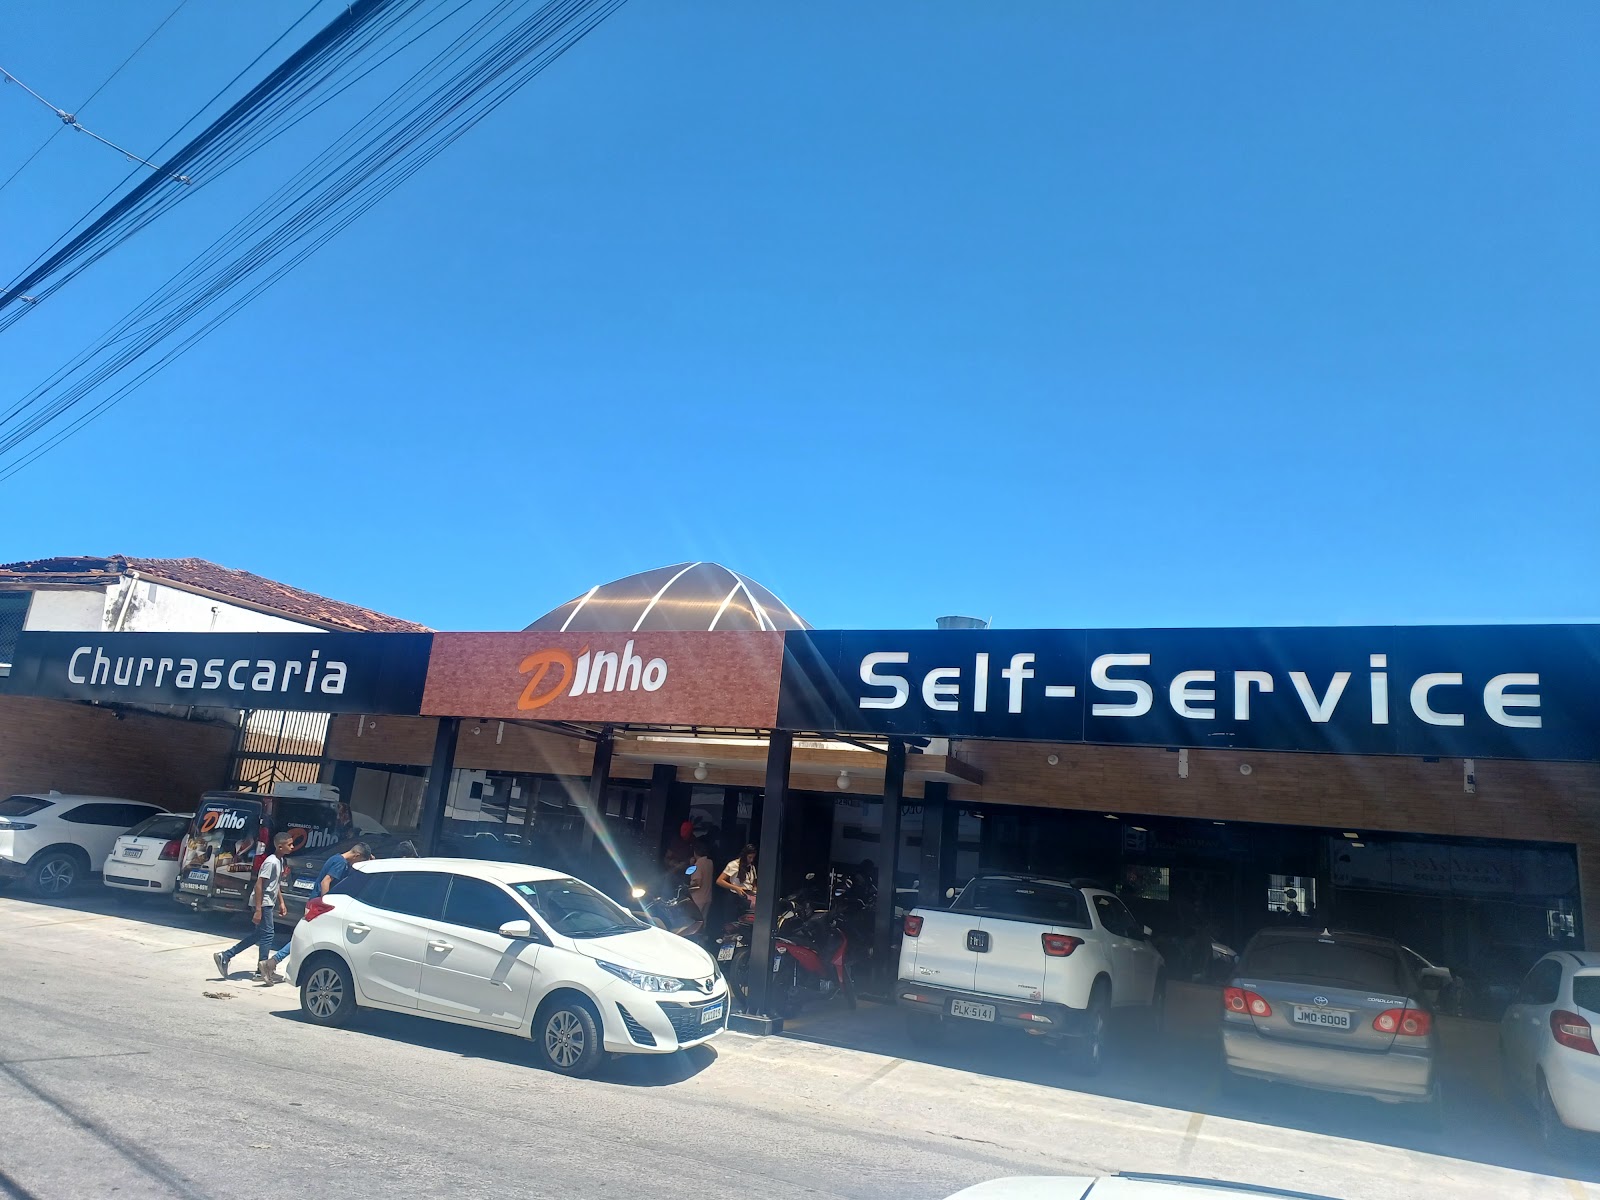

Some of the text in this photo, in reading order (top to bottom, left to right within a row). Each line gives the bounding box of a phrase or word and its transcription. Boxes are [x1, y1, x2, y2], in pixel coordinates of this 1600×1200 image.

[68, 646, 348, 695] Churrascaria
[517, 640, 668, 711] Dinho
[859, 651, 1542, 730] Self-Service
[200, 810, 246, 833] Dinho
